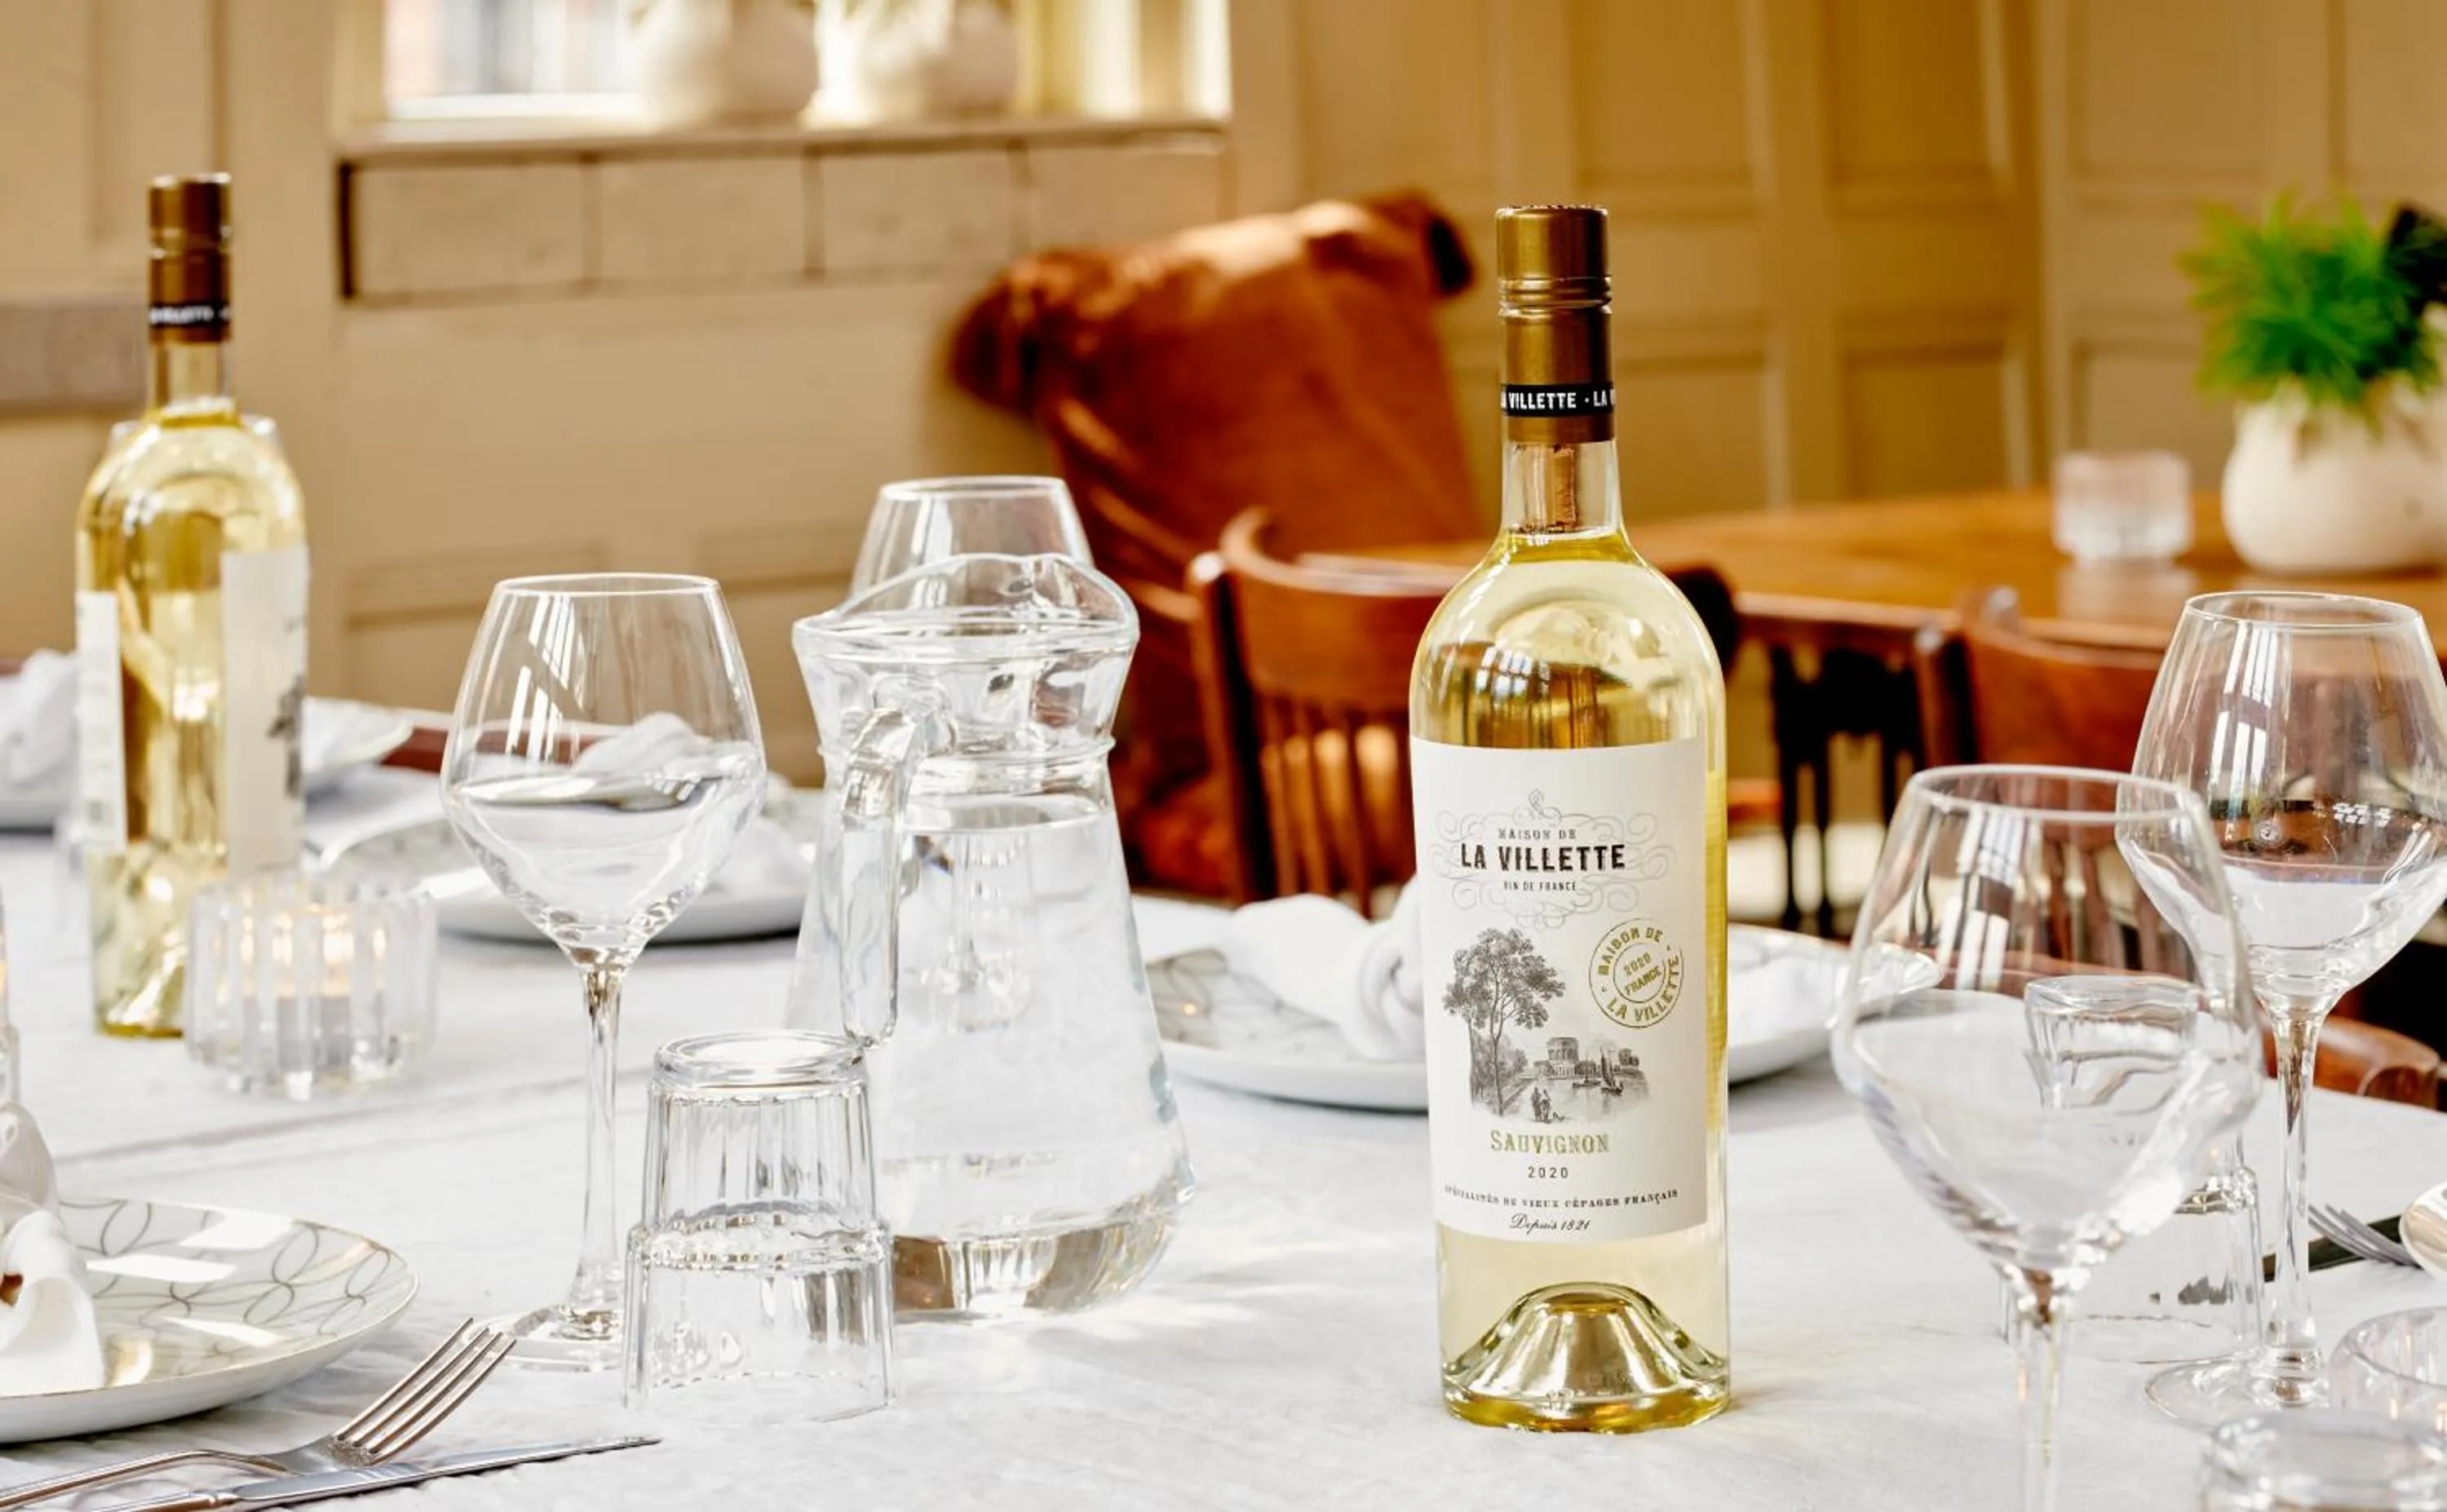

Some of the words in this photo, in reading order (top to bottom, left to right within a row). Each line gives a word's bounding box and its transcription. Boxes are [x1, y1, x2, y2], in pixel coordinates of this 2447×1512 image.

[1509, 392, 1577, 410] VILLETTE
[1593, 390, 1608, 407] LA
[1498, 828, 1551, 839] MAISON
[1559, 829, 1577, 839] DE
[1461, 843, 1486, 869] LA
[1498, 844, 1626, 872] VILLETTE
[1504, 881, 1519, 891] VIN
[1523, 882, 1533, 891] DE
[1539, 881, 1577, 891] FRANCE
[1598, 927, 1640, 975] MAISON
[1645, 926, 1663, 943] DE
[1623, 952, 1652, 976] 2020
[1607, 997, 1627, 1019] LA
[1635, 955, 1679, 1022] VILLETTE
[1624, 965, 1662, 996] FRANCE
[1490, 1130, 1609, 1154] SAUVIGNON
[1528, 1165, 1569, 1178] 2020
[1564, 1196, 1619, 1208] CÉPAGES
[1509, 1213, 1557, 1235] Depuis
[1560, 1219, 1591, 1231] 1821
